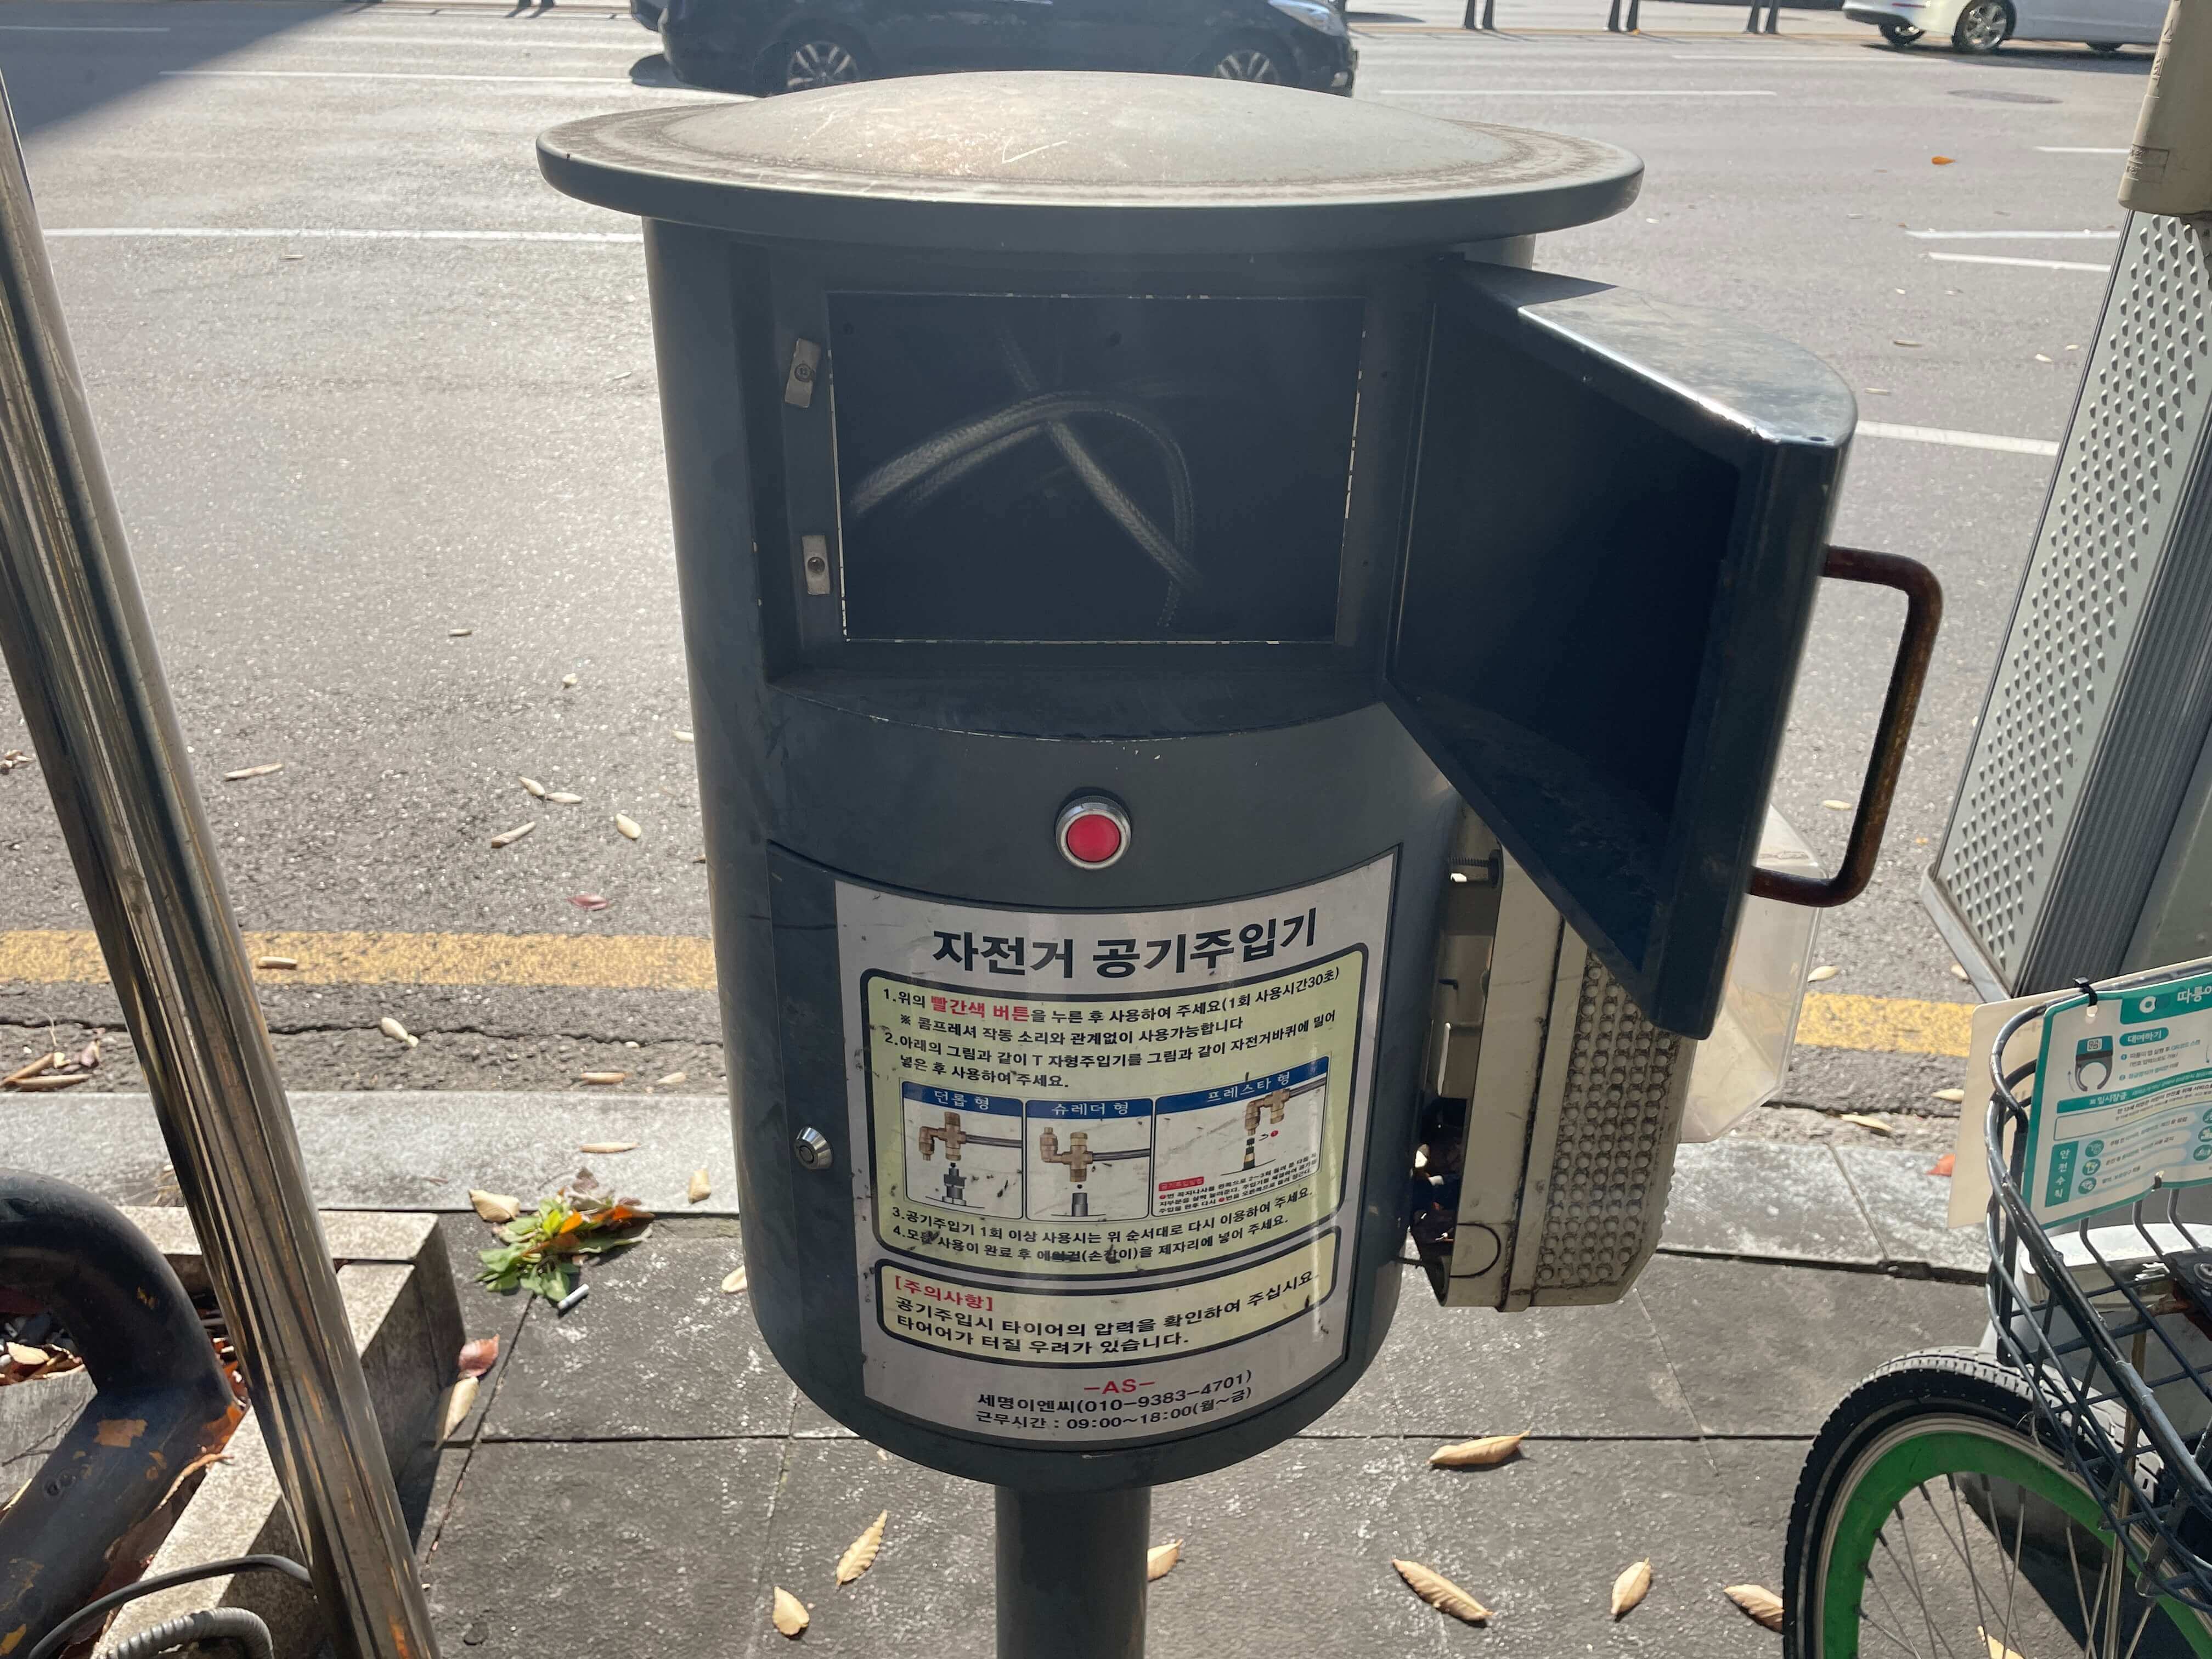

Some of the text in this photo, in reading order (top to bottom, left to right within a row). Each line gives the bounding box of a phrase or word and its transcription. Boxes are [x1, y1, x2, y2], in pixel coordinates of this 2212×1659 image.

[933, 907, 1317, 979] 자전거 공기주입기
[884, 989, 926, 1009] 1.위의
[930, 996, 985, 1019] 빨간색
[1051, 1011, 1083, 1023] 누른
[1088, 1010, 1104, 1024] 후
[1109, 1006, 1171, 1024] 사용하여
[1176, 994, 1251, 1018] 주세요(1회
[1255, 966, 1340, 1003] 사용시간30초)
[884, 1010, 1336, 1068] 2.아래의 그림과 같이 T 자형주입기를 그림과 같이 자전거바퀴에 밀어
[918, 1017, 977, 1039] 콤프레셔
[983, 1027, 1013, 1042] 작동
[1018, 1030, 1065, 1046] 소리와
[1070, 1029, 1133, 1045] 관계없이
[1138, 1016, 1244, 1042] 사용가능합니다
[900, 1054, 1069, 1088] 넣은 후 사용하여 주세요.
[1208, 1071, 1291, 1102] 프레스타 형
[934, 1090, 990, 1110] 던롭 형
[1051, 1102, 1128, 1116] 슈레더 형
[892, 1187, 1313, 1244] 3.공기주입기 1회 이상 사용시는 위 순서대로 다시 이용하여 주세요.
[936, 1237, 979, 1255] 사용이
[984, 1244, 1014, 1259] 완료
[1018, 1248, 1031, 1261] 후
[1158, 1235, 1213, 1255] 제자리에
[1218, 1227, 1244, 1244] 넣어
[1247, 1214, 1289, 1235] 주세요.
[895, 1274, 994, 1312] [주의사항]
[895, 1296, 994, 1331] 공기주입시
[1002, 1320, 1086, 1337] 타이어의
[1094, 1318, 1156, 1336] 압력을
[1163, 1299, 1241, 1328] 확인하여
[897, 1314, 1189, 1355] 타어어가 터질 우려가 있습니다.
[975, 1410, 1046, 1429] 근무시간
[1066, 1387, 1252, 1430] 09:00~18:00(월~금)
[977, 1369, 1252, 1414] 세명이엔씨(010-9383-4701)
